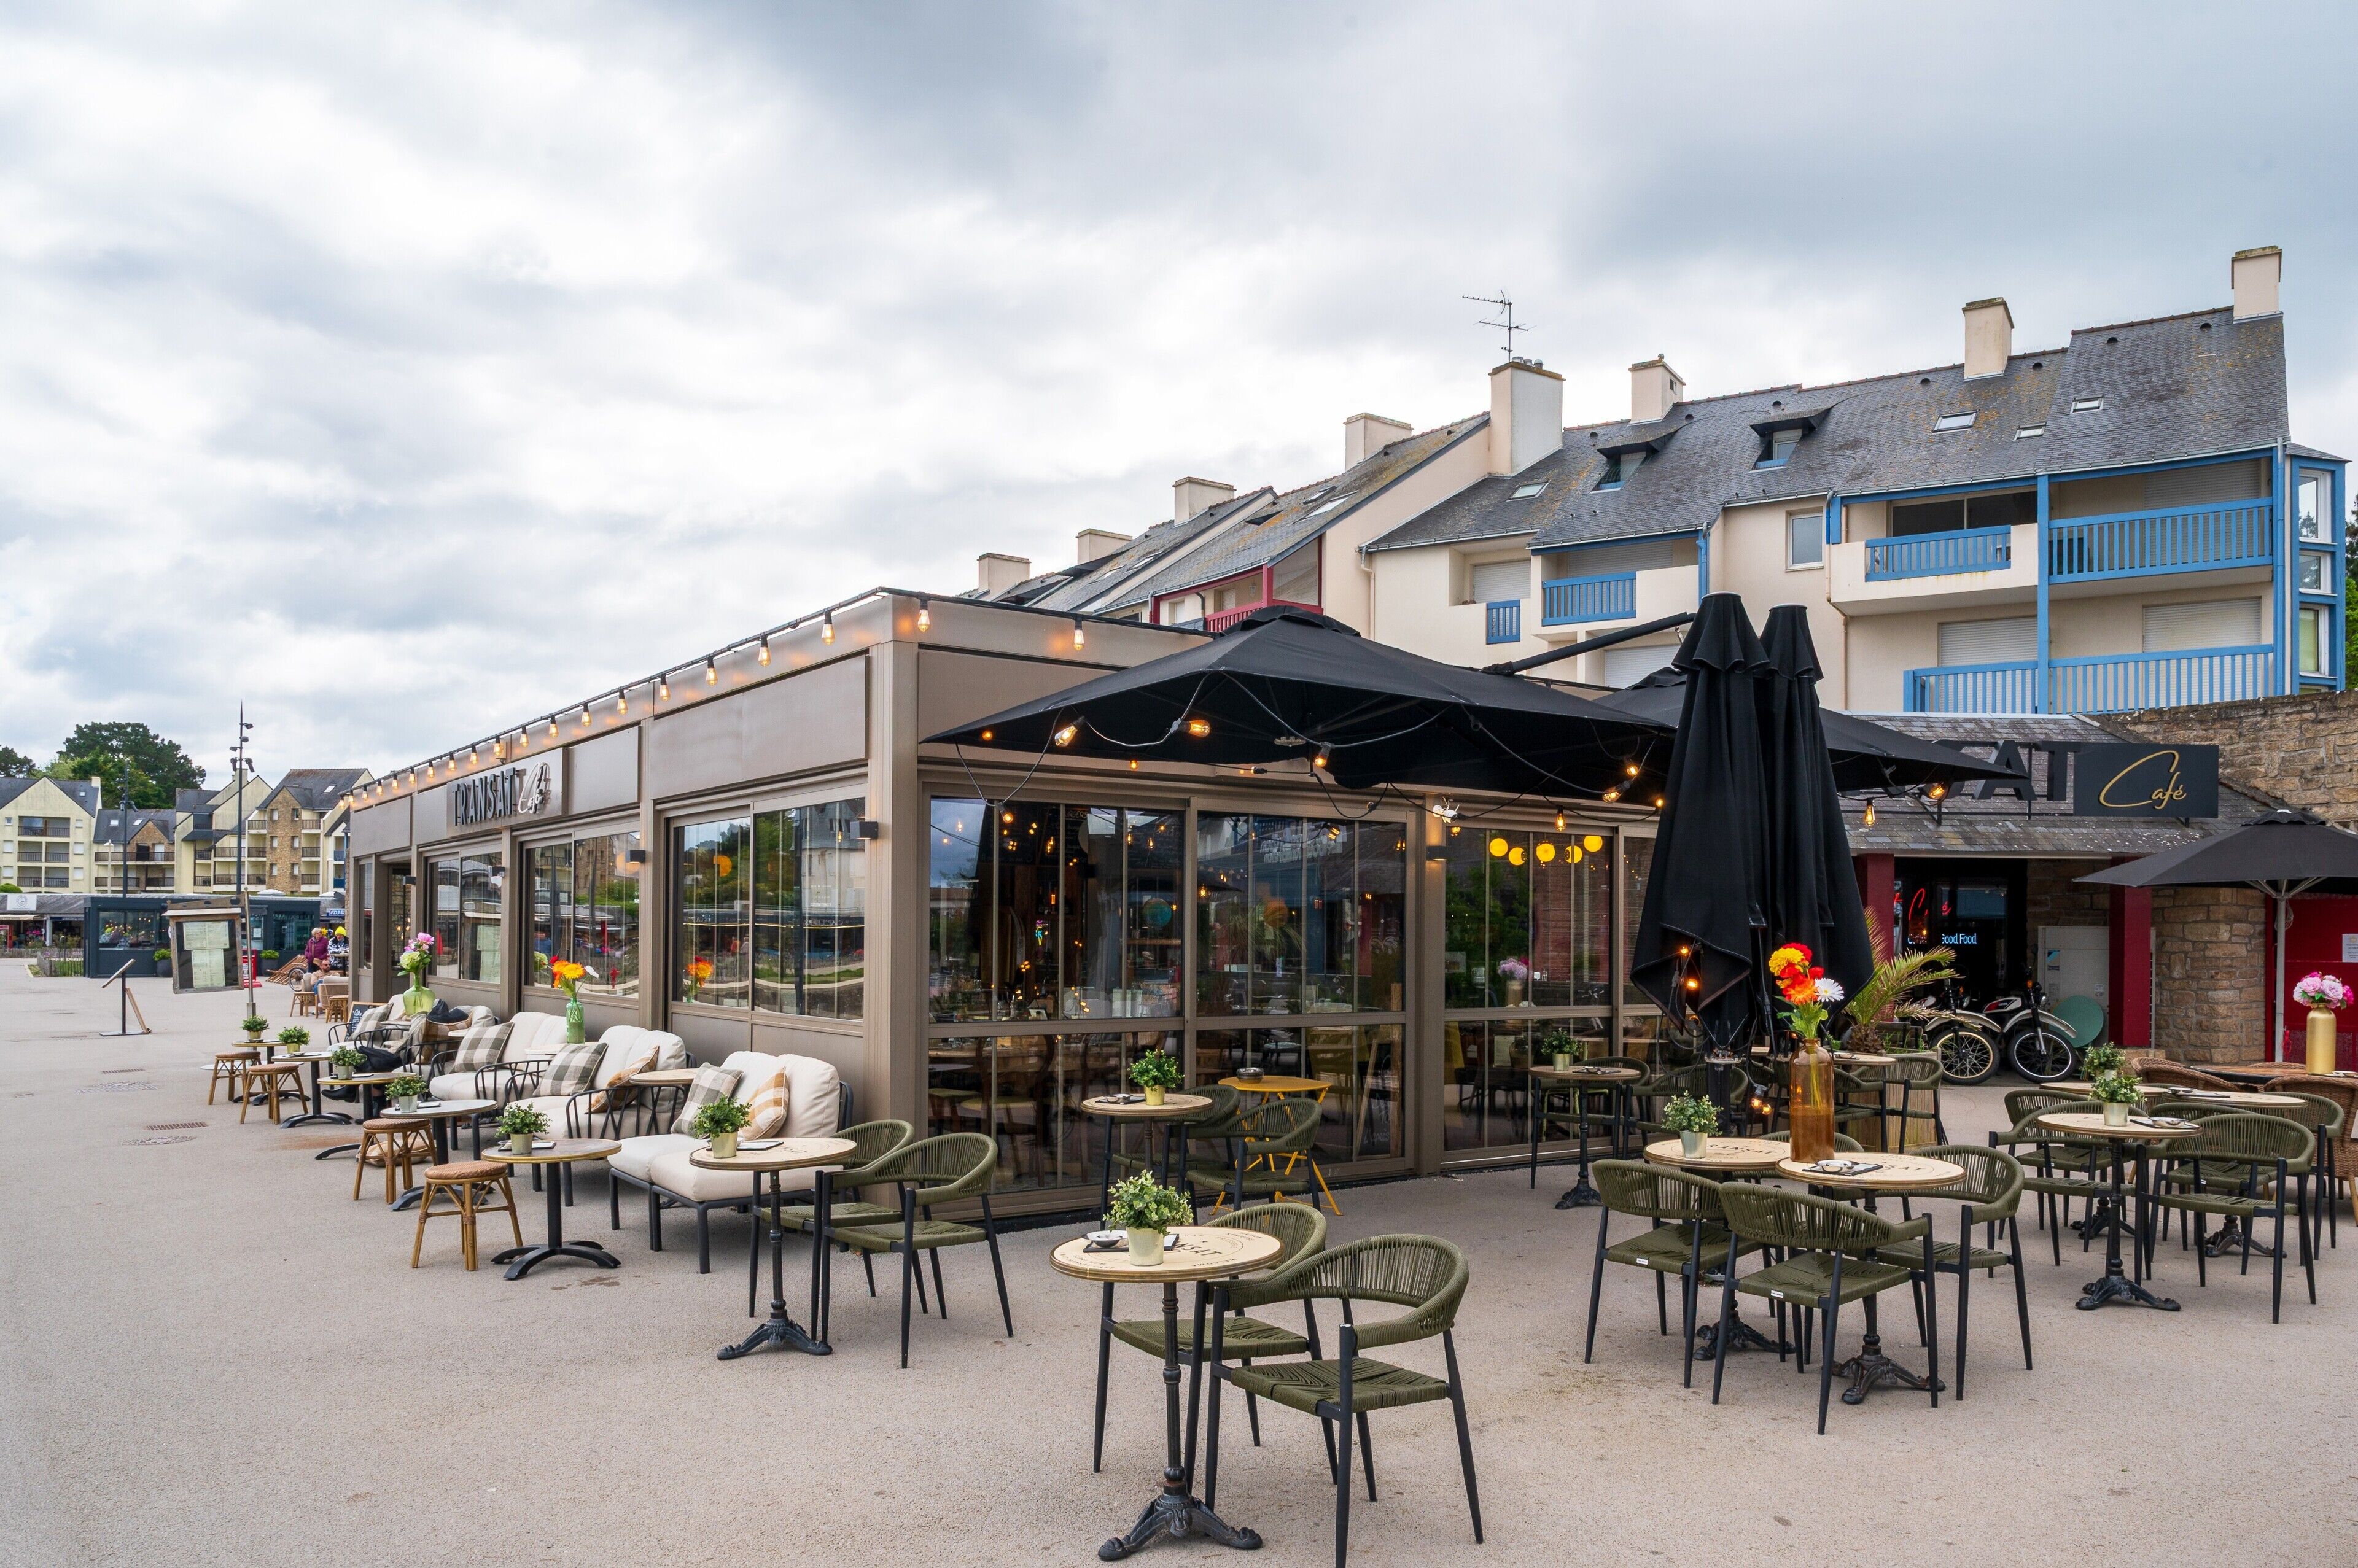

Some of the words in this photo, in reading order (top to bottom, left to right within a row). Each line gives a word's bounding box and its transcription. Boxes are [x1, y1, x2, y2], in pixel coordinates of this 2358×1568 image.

[2099, 750, 2187, 810] Café
[452, 767, 516, 826] TRANSAT
[1959, 933, 1977, 944] Food
[1708, 1144, 1776, 1154] RANSAT
[1175, 1243, 1223, 1256] NSAT
